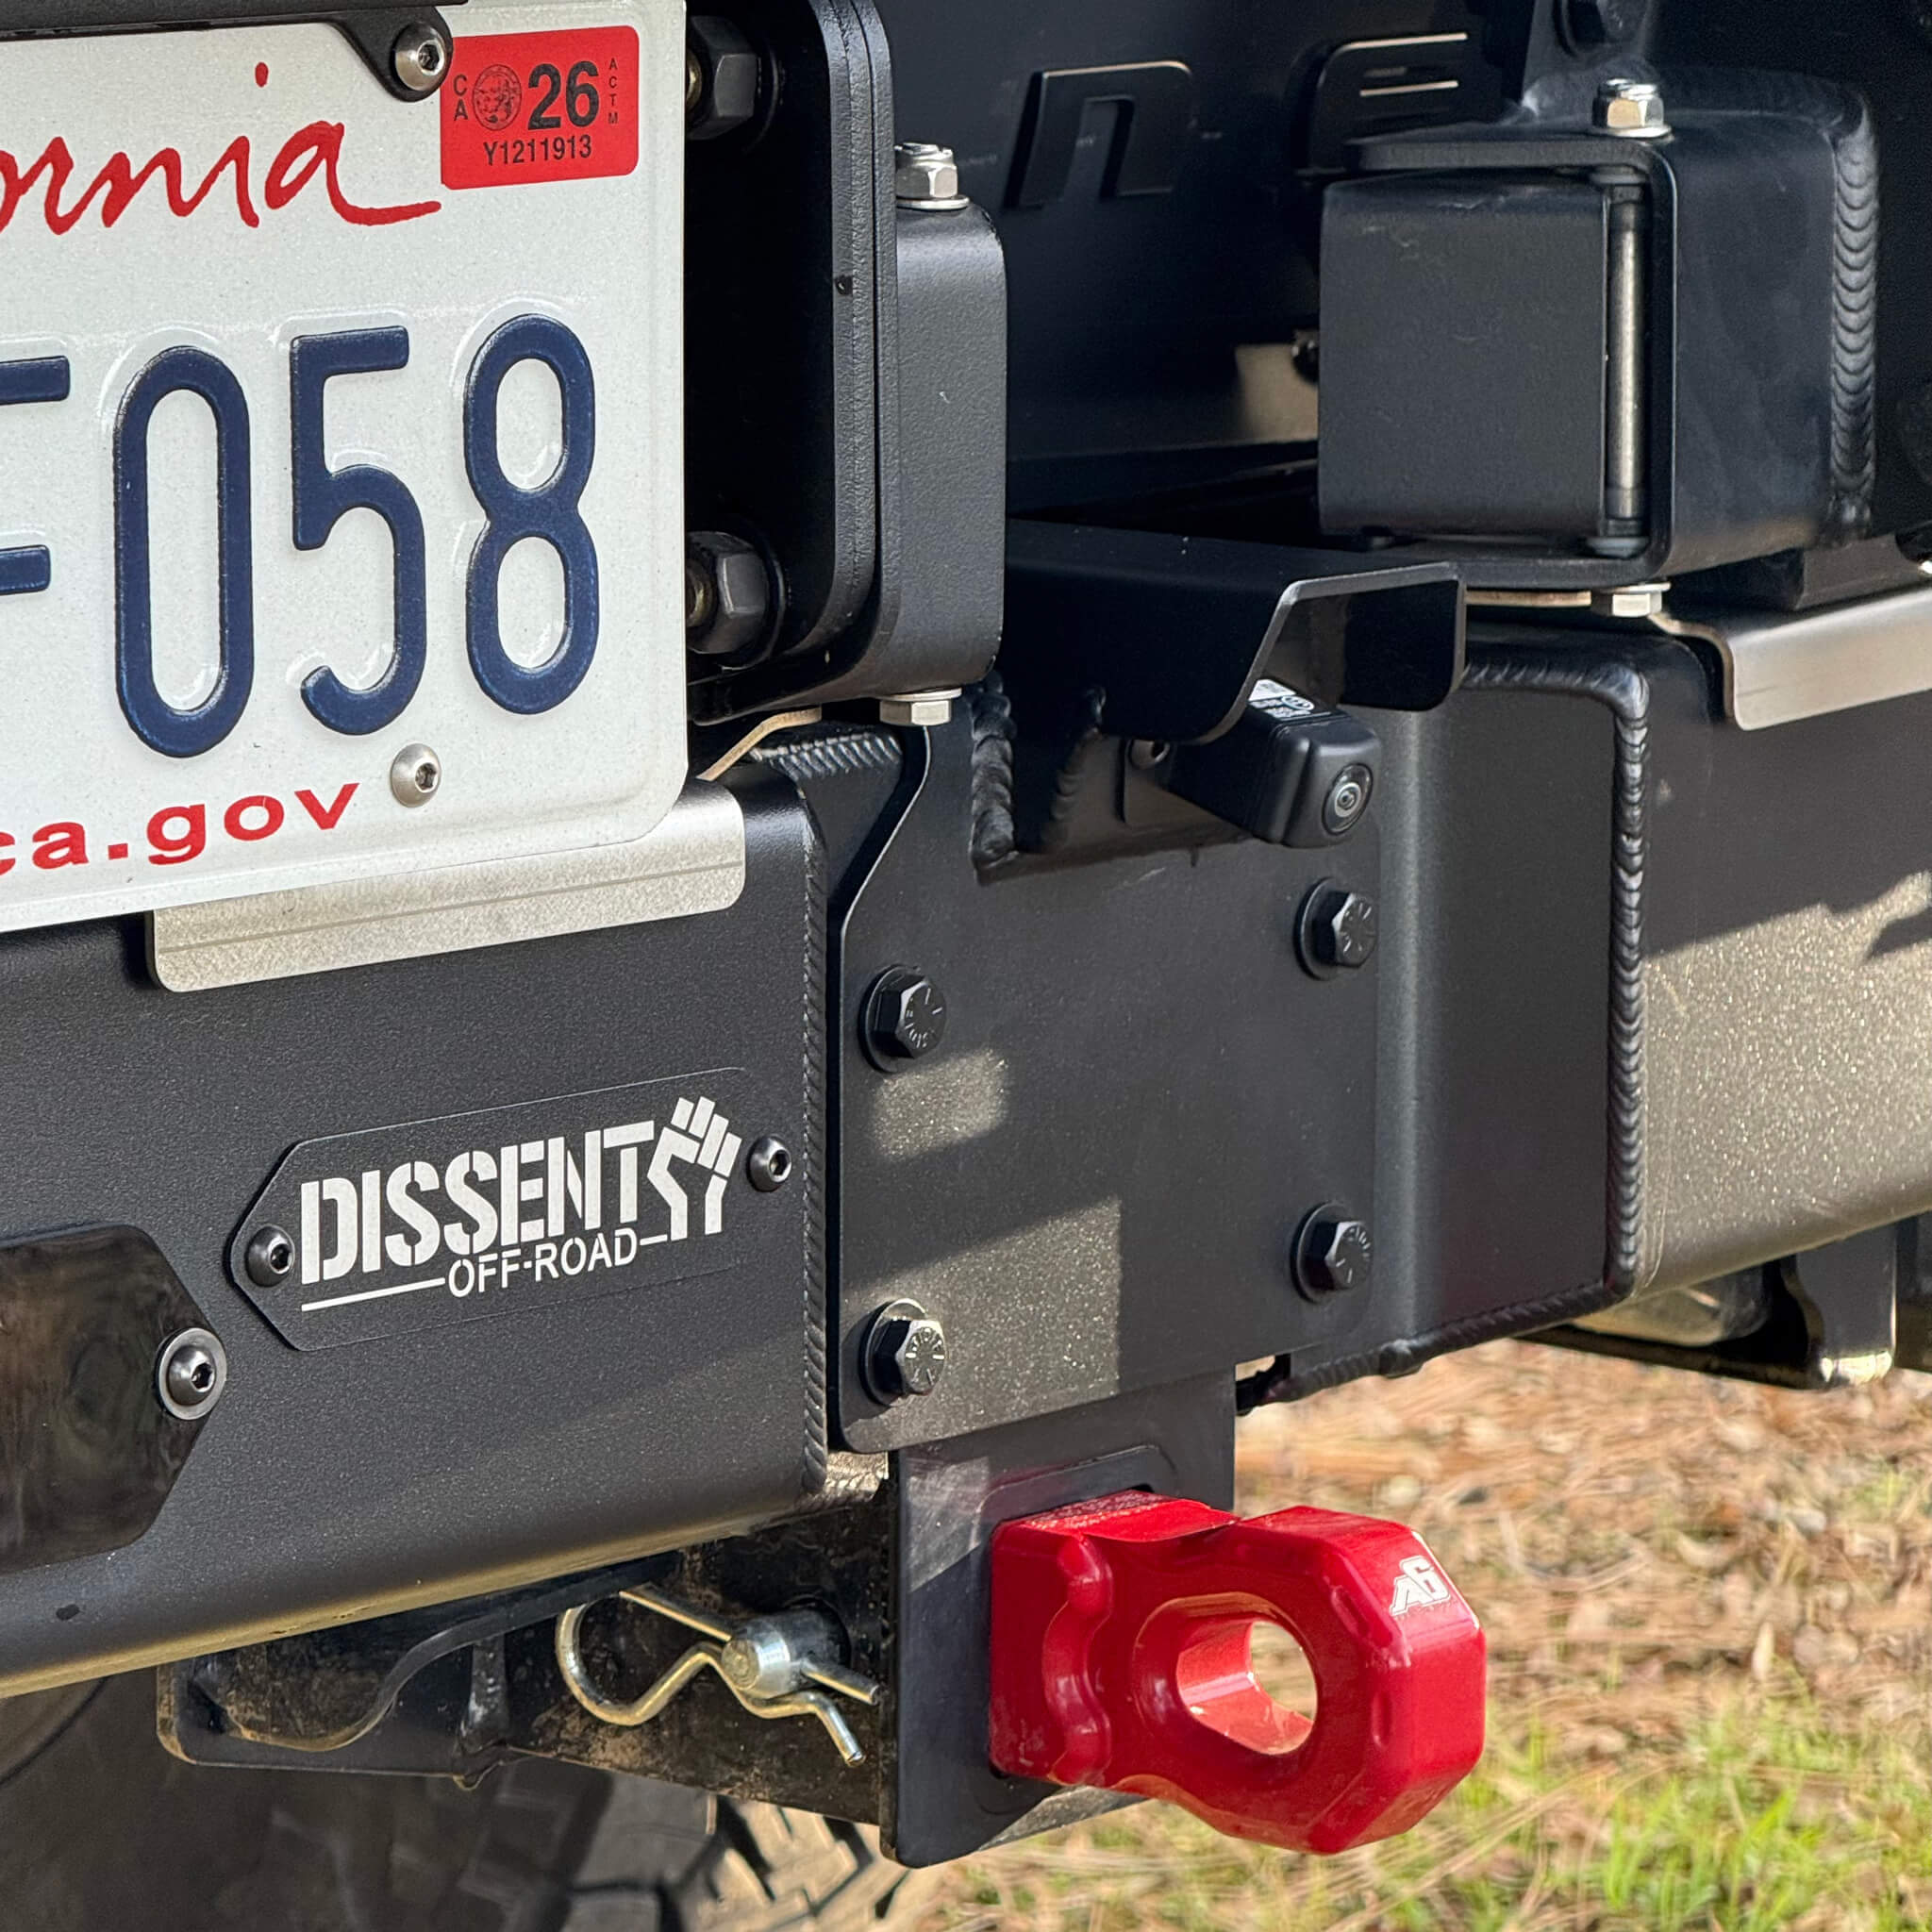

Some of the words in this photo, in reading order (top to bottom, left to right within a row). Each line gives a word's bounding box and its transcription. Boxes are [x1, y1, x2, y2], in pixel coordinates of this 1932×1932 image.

[453, 74, 469, 122] CA
[527, 60, 600, 130] 26
[483, 134, 592, 167] Y1211913
[300, 1119, 656, 1285] DISSENT
[447, 1227, 638, 1298] OFF-ROAD
